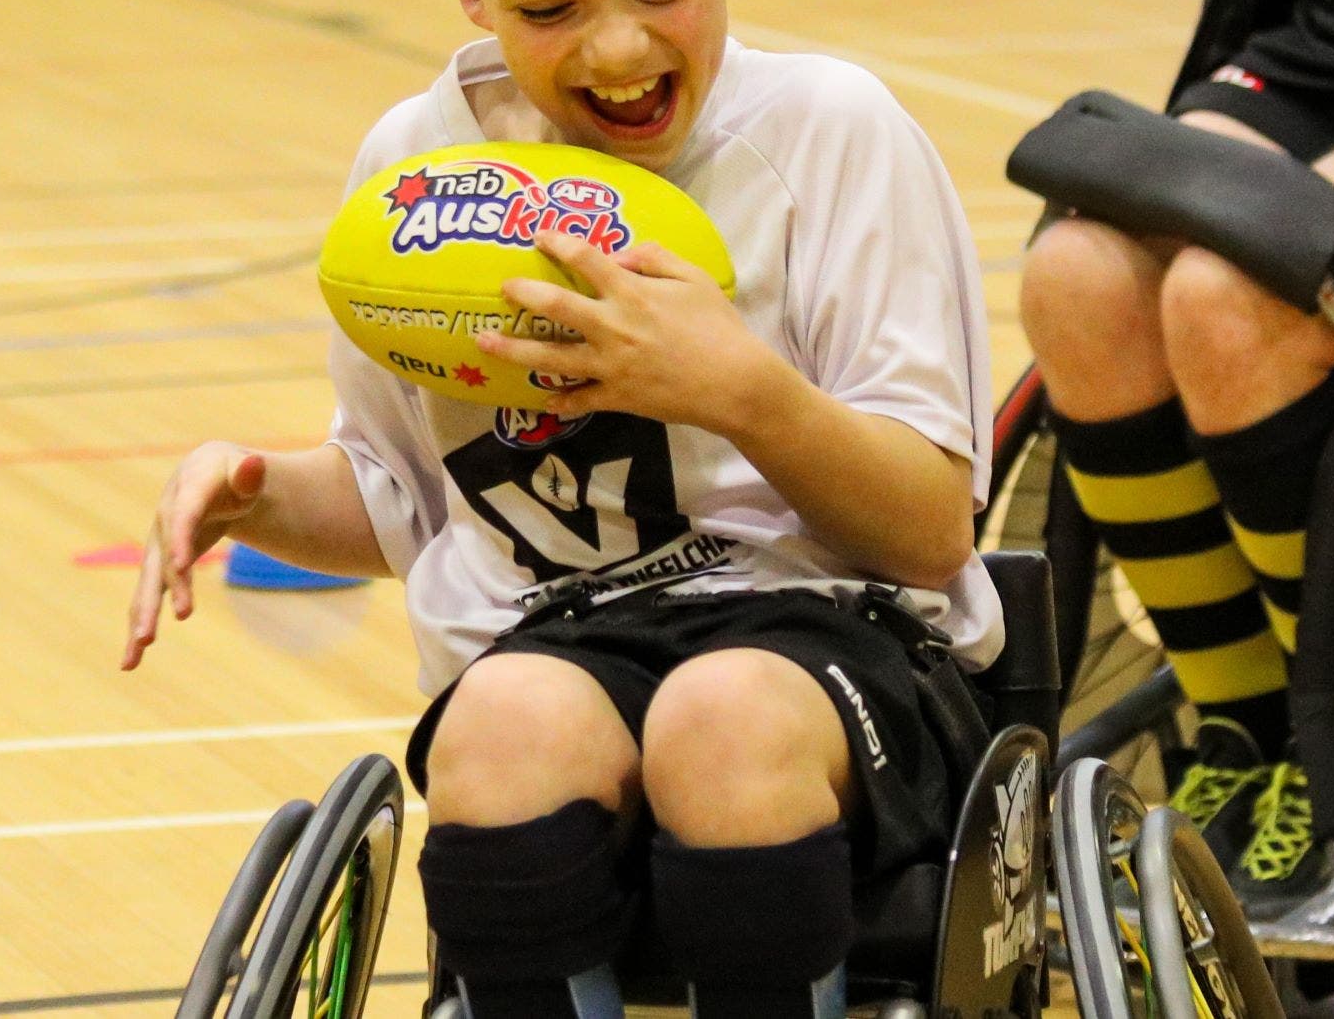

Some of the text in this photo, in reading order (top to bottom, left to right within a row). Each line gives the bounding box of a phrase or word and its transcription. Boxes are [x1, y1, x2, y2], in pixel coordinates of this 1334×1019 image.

[435, 171, 501, 196] nab
[551, 182, 613, 209] AFL
[388, 350, 447, 379] nab
